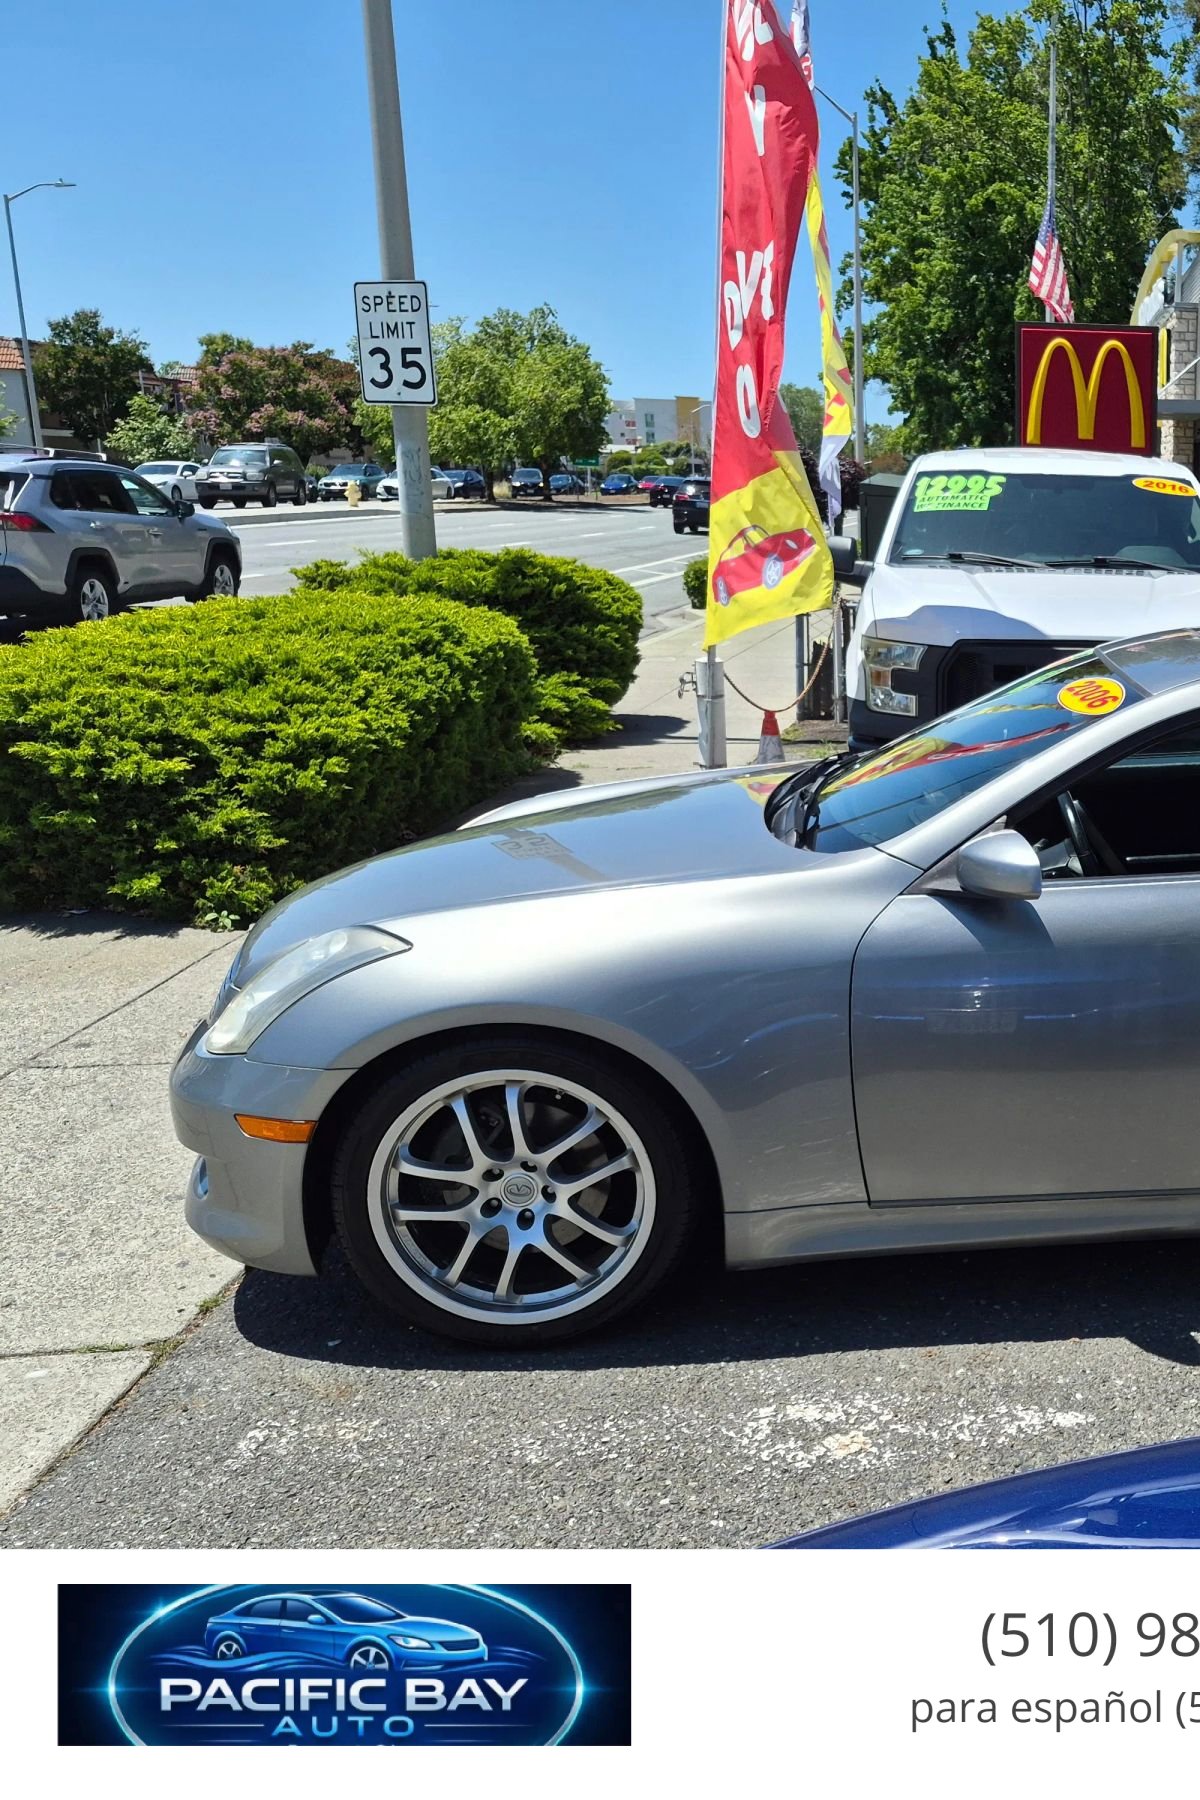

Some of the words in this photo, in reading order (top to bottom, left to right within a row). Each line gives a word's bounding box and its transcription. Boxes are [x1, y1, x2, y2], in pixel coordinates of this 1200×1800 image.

[361, 294, 422, 313] SPEED
[369, 321, 416, 339] LIMIT
[368, 346, 427, 390] 35
[915, 475, 1006, 497] 12995
[1142, 480, 1190, 494] 2016
[918, 494, 989, 503] AUTOMATIC
[1066, 680, 1119, 709] 2006
